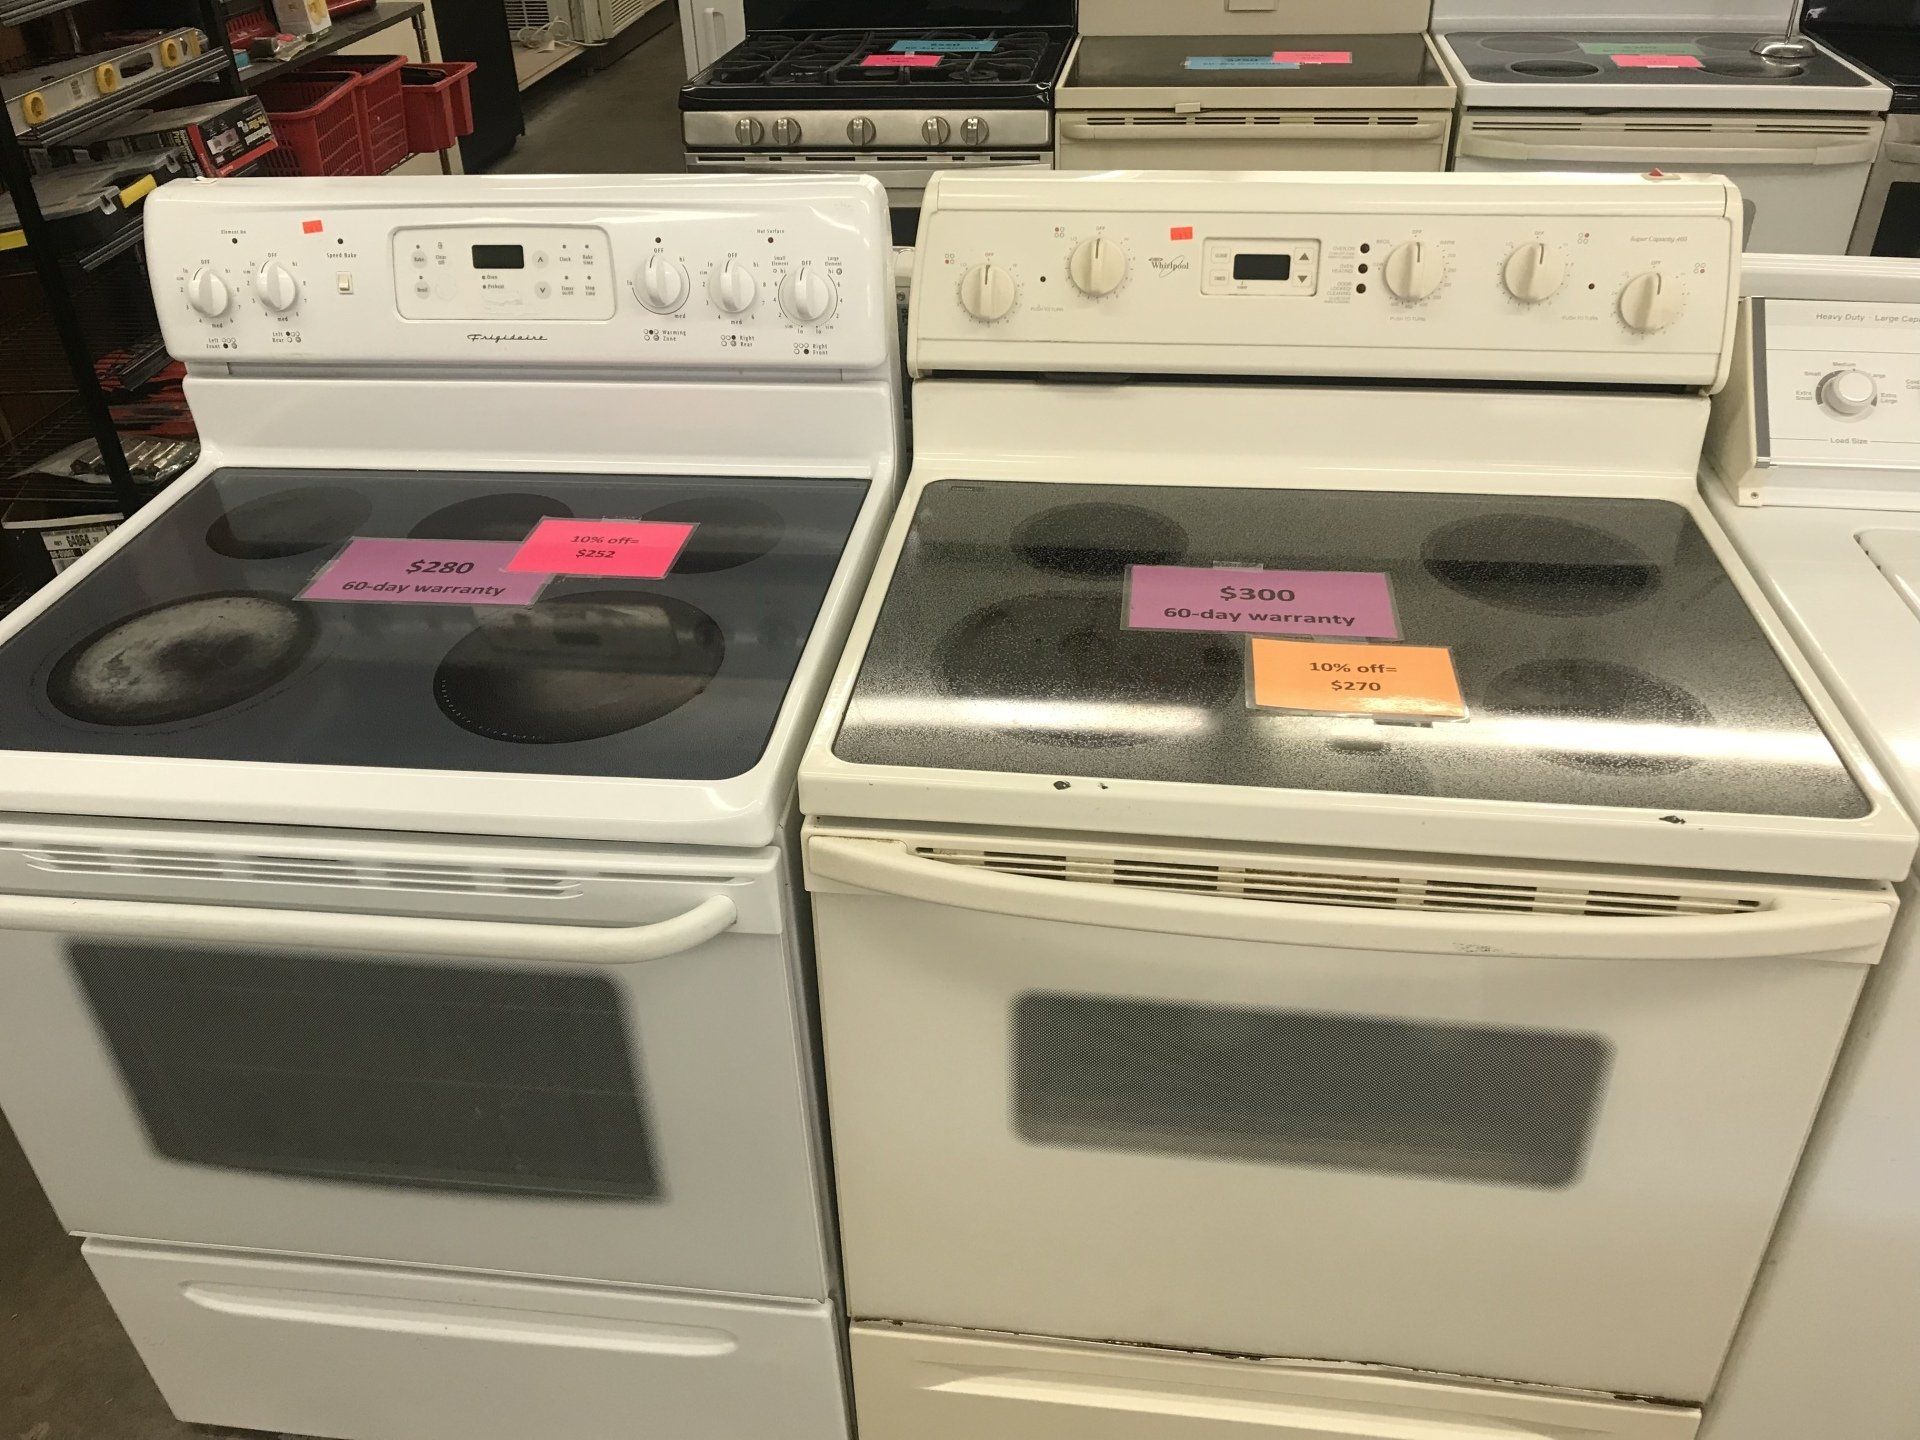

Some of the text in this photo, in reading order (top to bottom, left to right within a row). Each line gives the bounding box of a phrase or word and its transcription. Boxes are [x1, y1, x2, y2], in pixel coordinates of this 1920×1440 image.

[1151, 261, 1189, 271] Whirlpool
[1816, 313, 1843, 321] Heavy
[1845, 313, 1865, 321] Duty
[1874, 315, 1899, 323] Large
[467, 333, 548, 344] Frigidaire
[570, 535, 640, 546] 10% off=
[576, 548, 615, 560] $252
[406, 559, 475, 576] $280
[341, 580, 506, 598] 60-day warranty
[1220, 585, 1296, 602] $300
[1163, 607, 1356, 627] 60-day warranty
[1310, 661, 1397, 674] 10% off=
[1331, 679, 1381, 692] $270
